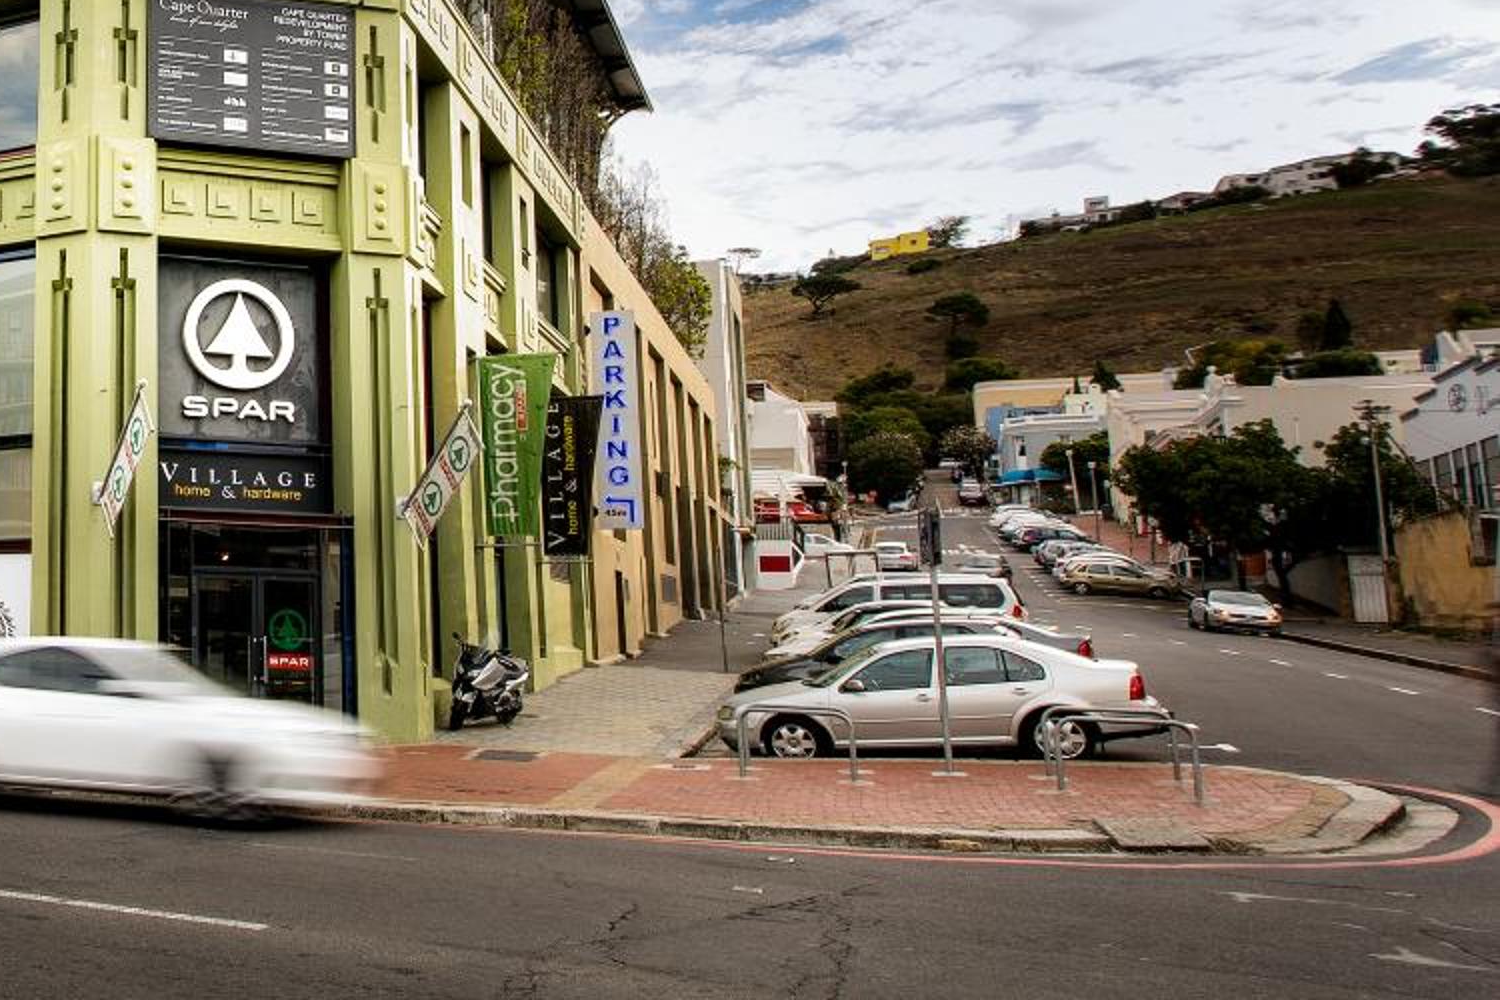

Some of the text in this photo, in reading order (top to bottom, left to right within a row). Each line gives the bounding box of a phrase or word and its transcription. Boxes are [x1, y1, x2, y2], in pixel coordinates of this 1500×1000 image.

[197, 0, 249, 20] Quarter
[281, 7, 304, 19] CAPE
[183, 395, 296, 424] SPAR
[603, 317, 630, 486] PARKING
[491, 362, 527, 523] Pharmacy
[563, 415, 576, 471] hardware
[160, 461, 317, 489] VILLAGE
[548, 402, 567, 548] VILLAGE
[173, 484, 302, 501] home & hardware
[269, 655, 309, 668] SPAR
